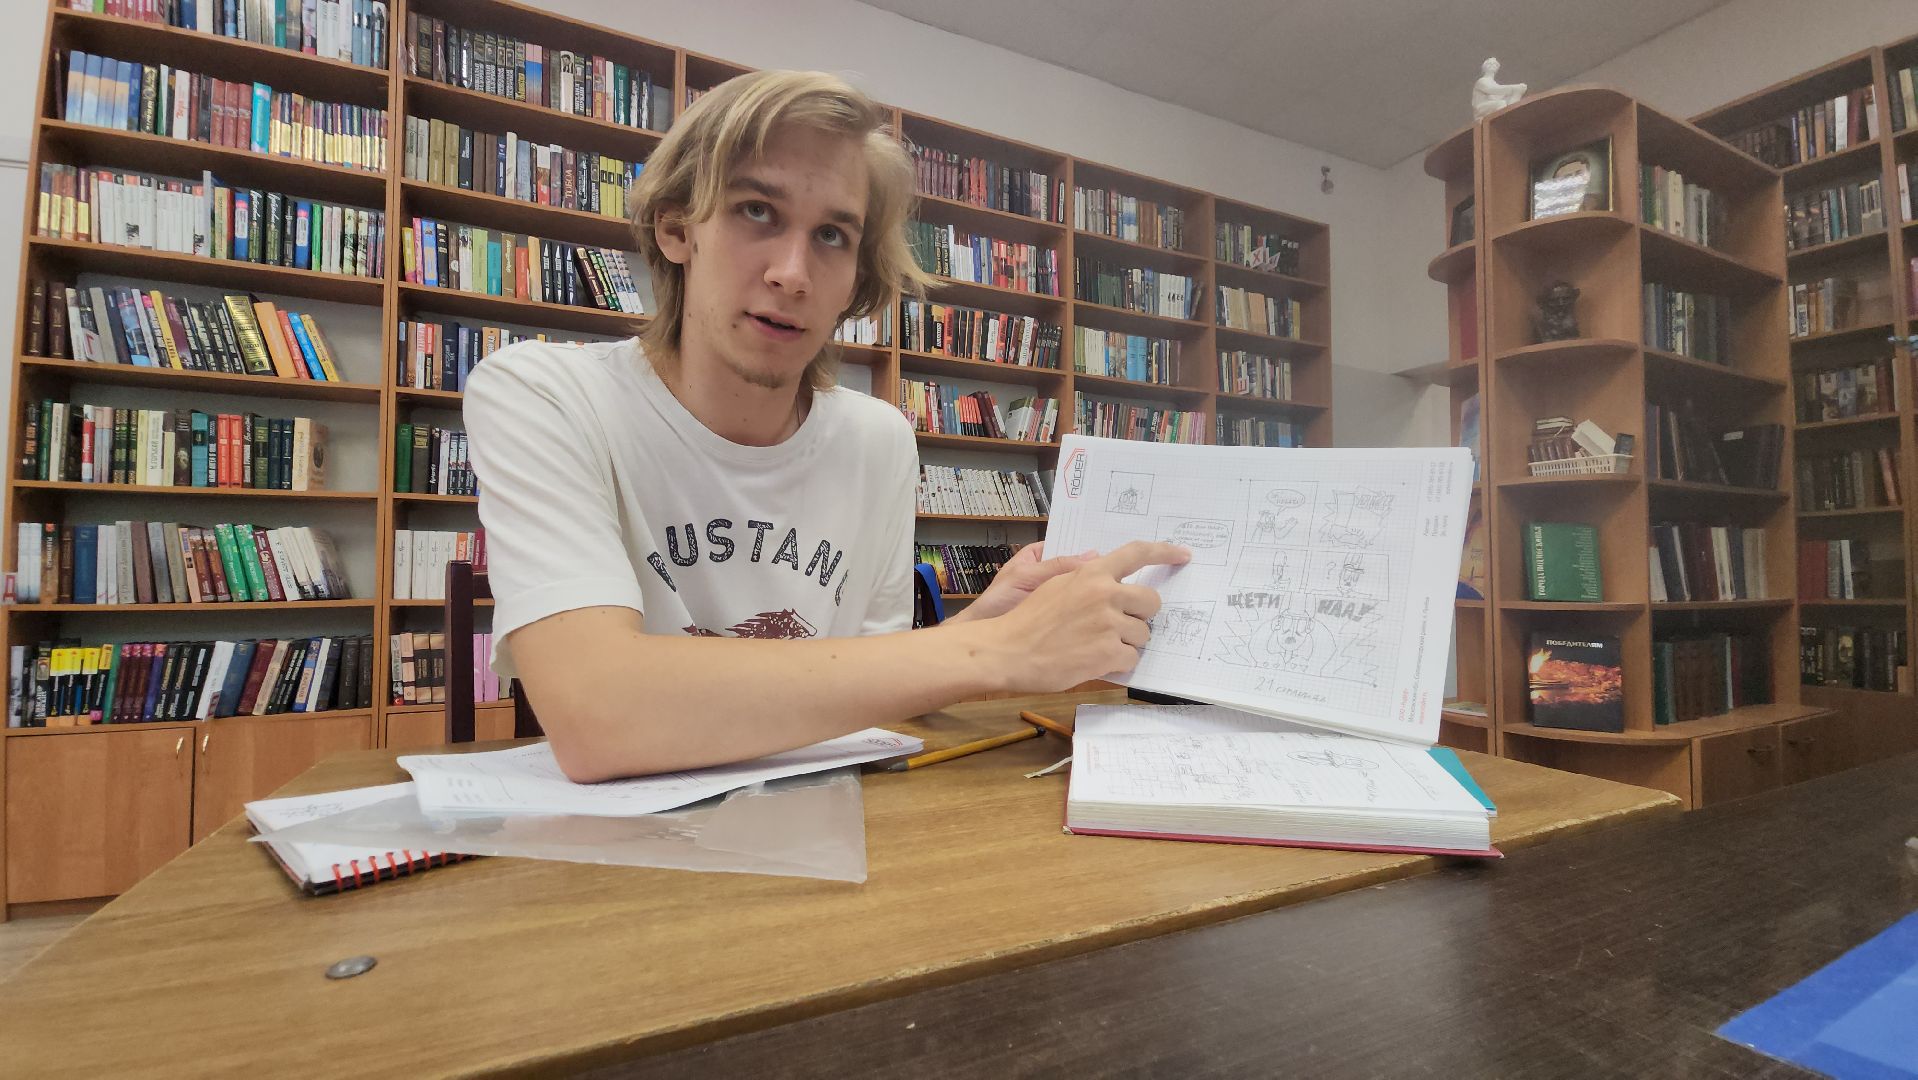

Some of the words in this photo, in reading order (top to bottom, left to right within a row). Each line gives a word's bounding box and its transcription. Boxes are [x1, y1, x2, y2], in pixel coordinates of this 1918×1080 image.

[564, 169, 574, 198] ТОБОЛ
[647, 518, 869, 606] USTAN
[1227, 592, 1281, 609] ЩЕТИ
[1546, 639, 1604, 649] ПОБЕДИТЕЛЯМ
[1254, 676, 1274, 691] 21
